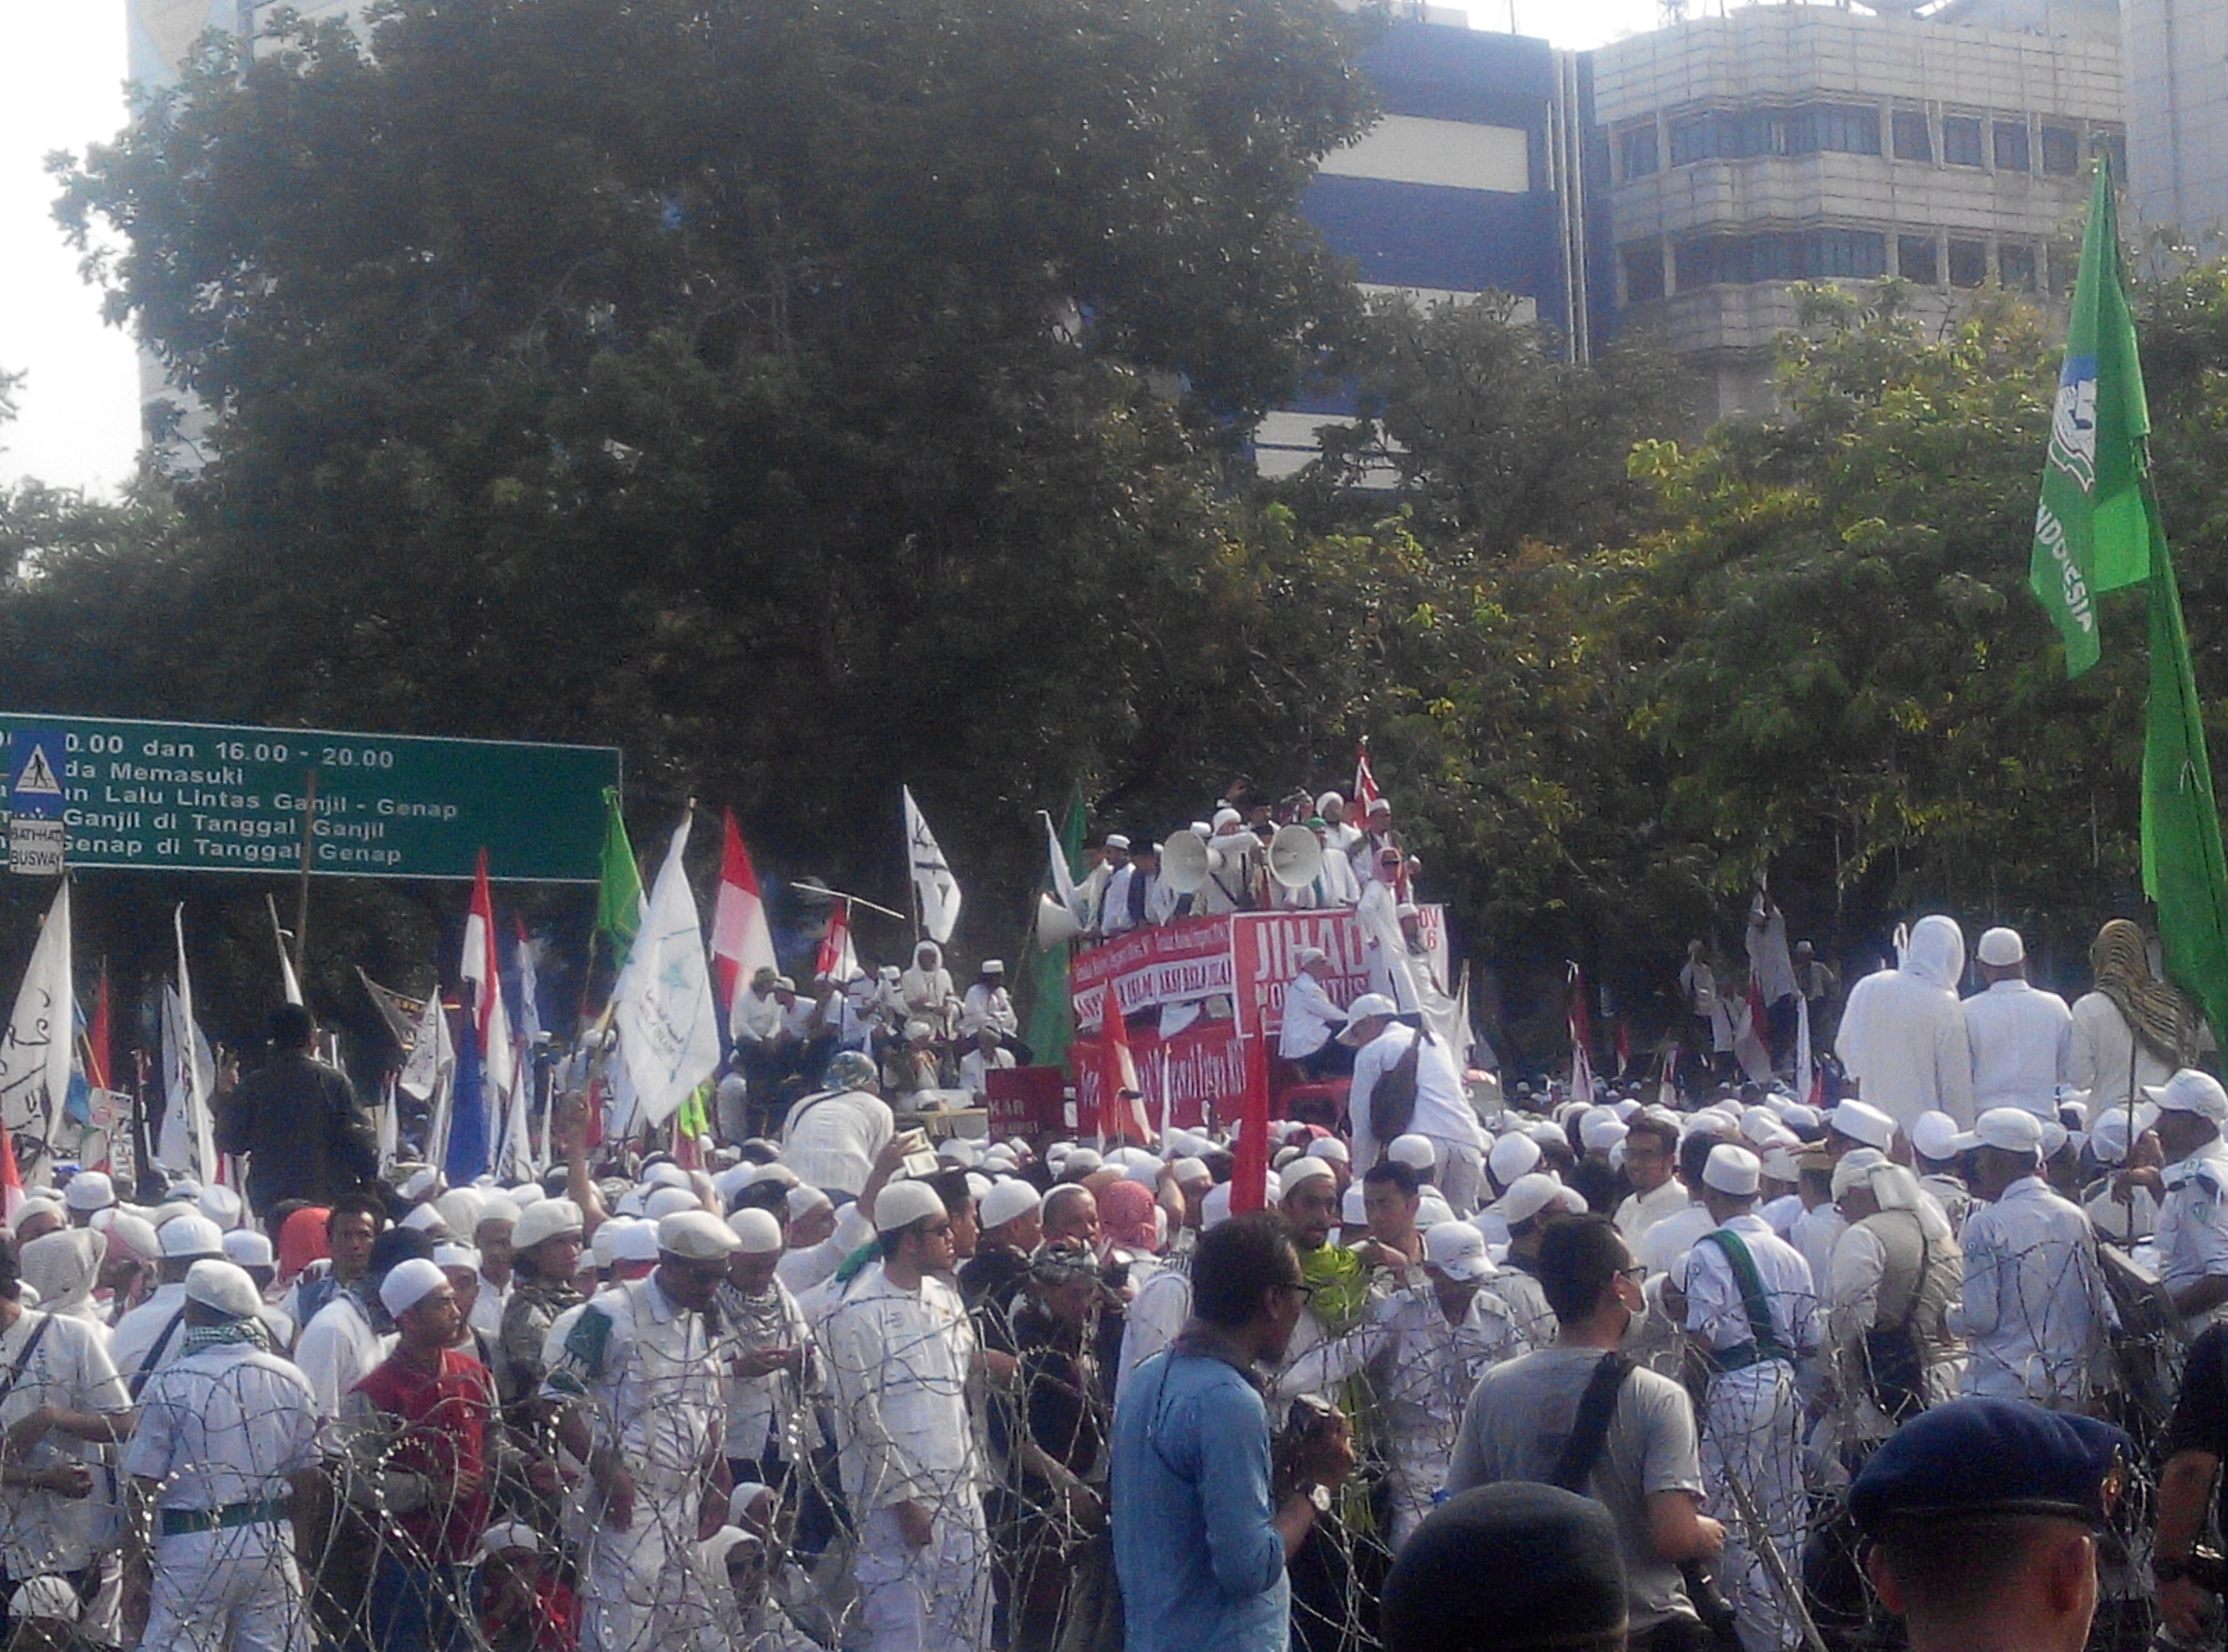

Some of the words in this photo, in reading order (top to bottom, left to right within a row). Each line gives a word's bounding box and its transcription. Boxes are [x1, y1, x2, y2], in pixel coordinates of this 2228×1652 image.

[66, 734, 123, 753] 0.00
[143, 740, 194, 757] dan
[216, 742, 287, 762] 16.00
[322, 748, 393, 768] 20.00
[66, 761, 95, 777] da
[111, 762, 242, 784] Memasuki
[106, 786, 162, 803] Lalu
[178, 789, 259, 808] Lintas
[274, 794, 346, 816] Ganjil
[378, 799, 456, 820] Genap
[63, 809, 140, 832] Ganjil
[154, 813, 175, 829] di
[192, 814, 294, 837] Tanggal
[312, 820, 383, 840] Ganjil
[11, 850, 61, 866] BUSWAY
[63, 836, 141, 858] Genap
[158, 839, 179, 854] di
[194, 839, 300, 861] Tanggal
[319, 844, 400, 865] Genap
[1419, 907, 1440, 928] OV
[1255, 918, 1368, 981] JIHAD
